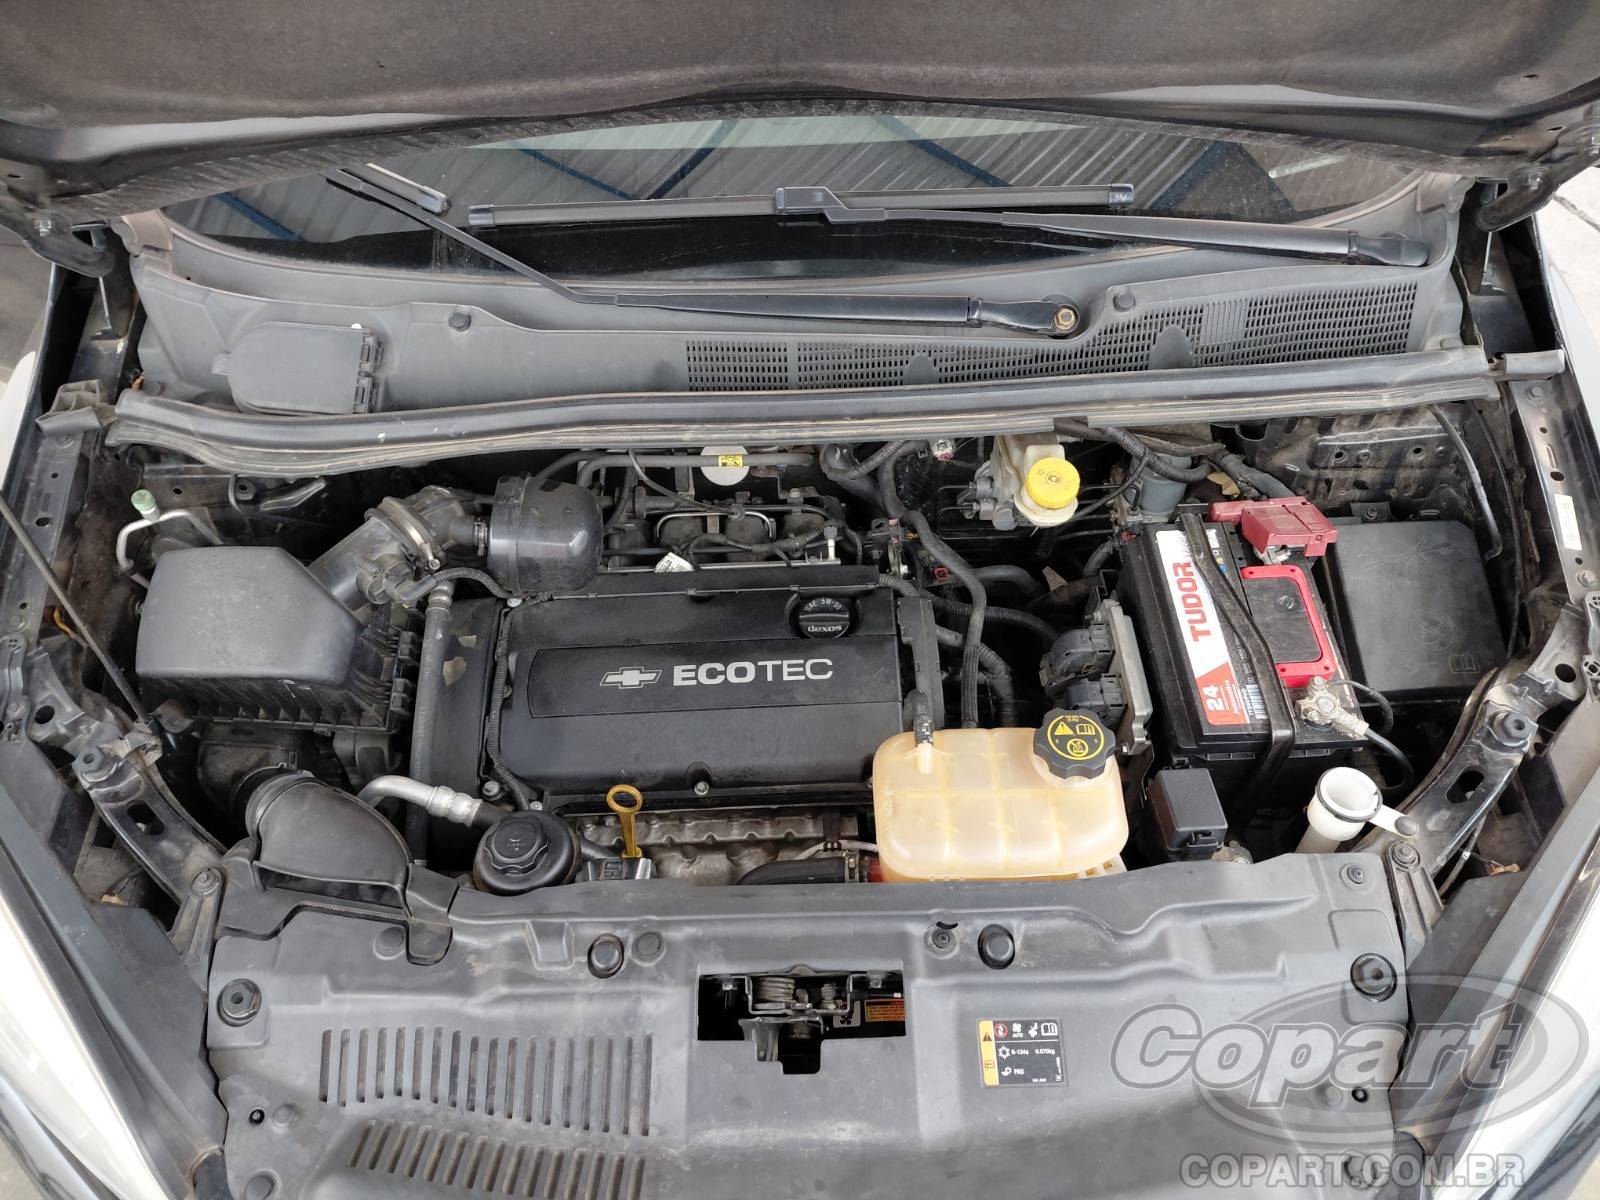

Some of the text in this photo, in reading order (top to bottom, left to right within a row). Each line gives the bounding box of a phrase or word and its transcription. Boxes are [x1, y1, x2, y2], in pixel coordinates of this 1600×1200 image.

[1172, 562, 1212, 641] TUDOR
[807, 624, 842, 632] dexos
[673, 658, 834, 687] ECOTEC
[1202, 685, 1225, 711] 24
